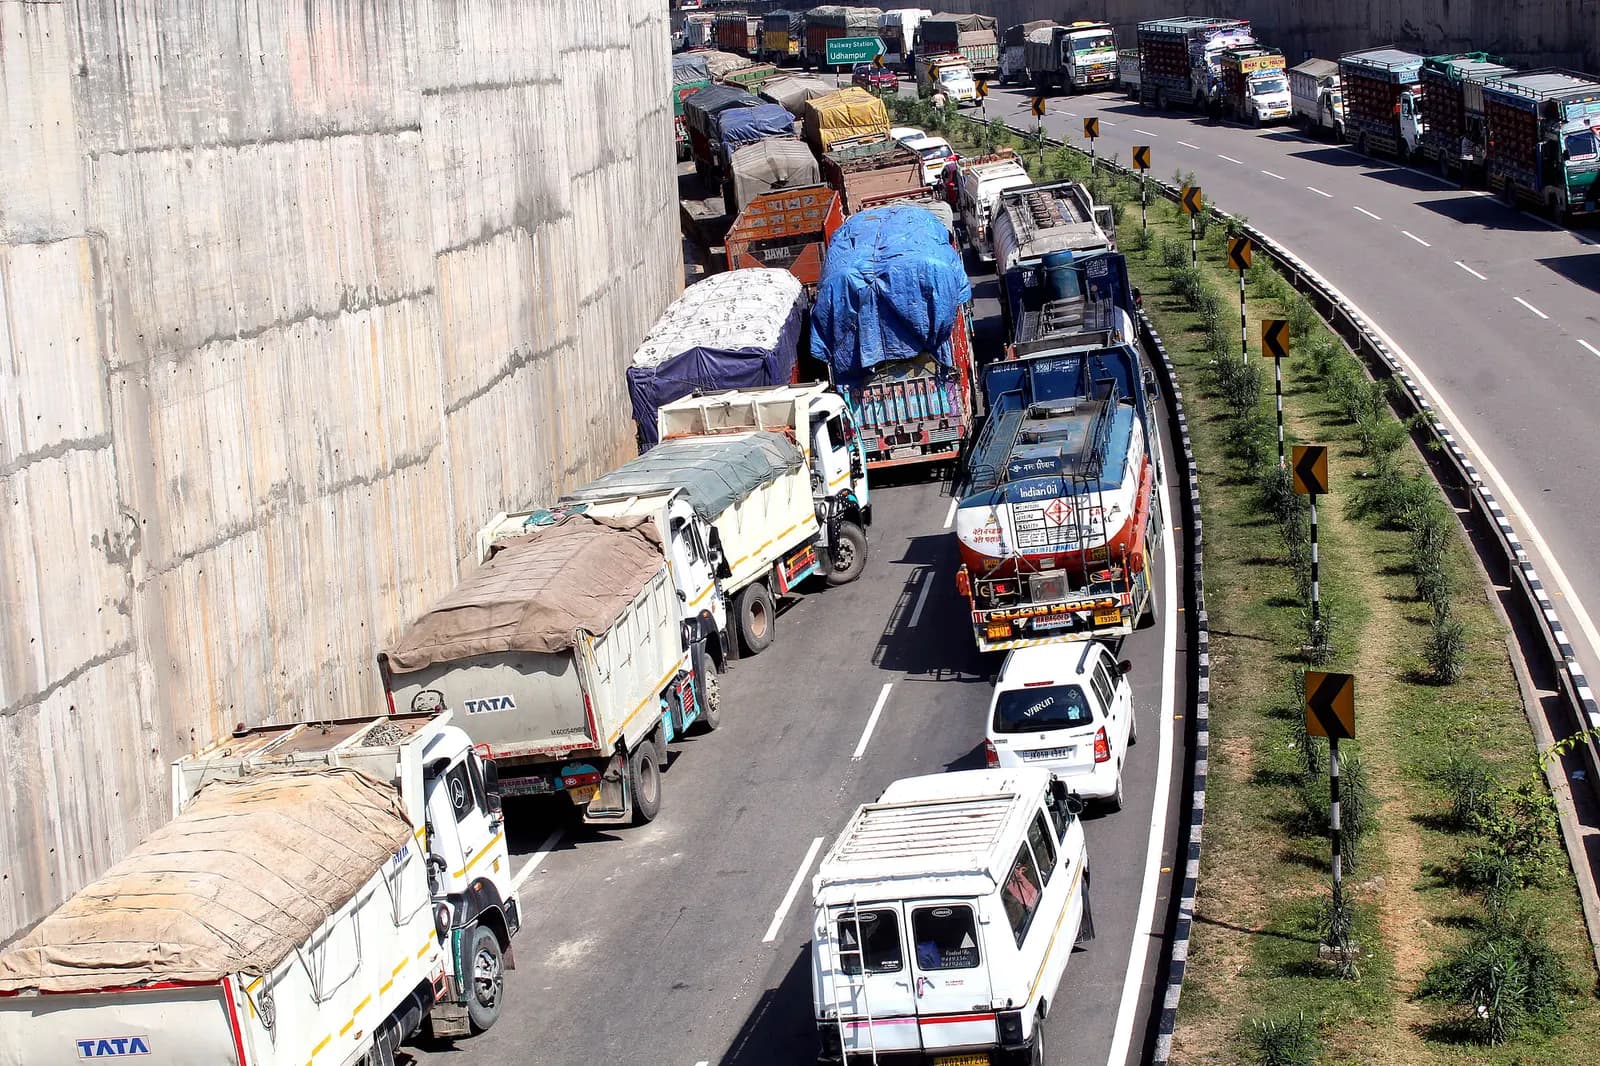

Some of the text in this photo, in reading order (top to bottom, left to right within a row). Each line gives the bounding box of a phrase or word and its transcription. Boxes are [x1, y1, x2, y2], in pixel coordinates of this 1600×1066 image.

[830, 52, 867, 60] Udhampur
[464, 697, 516, 713] TATA
[1023, 696, 1055, 717] VARUN
[77, 1037, 149, 1057] TATA
